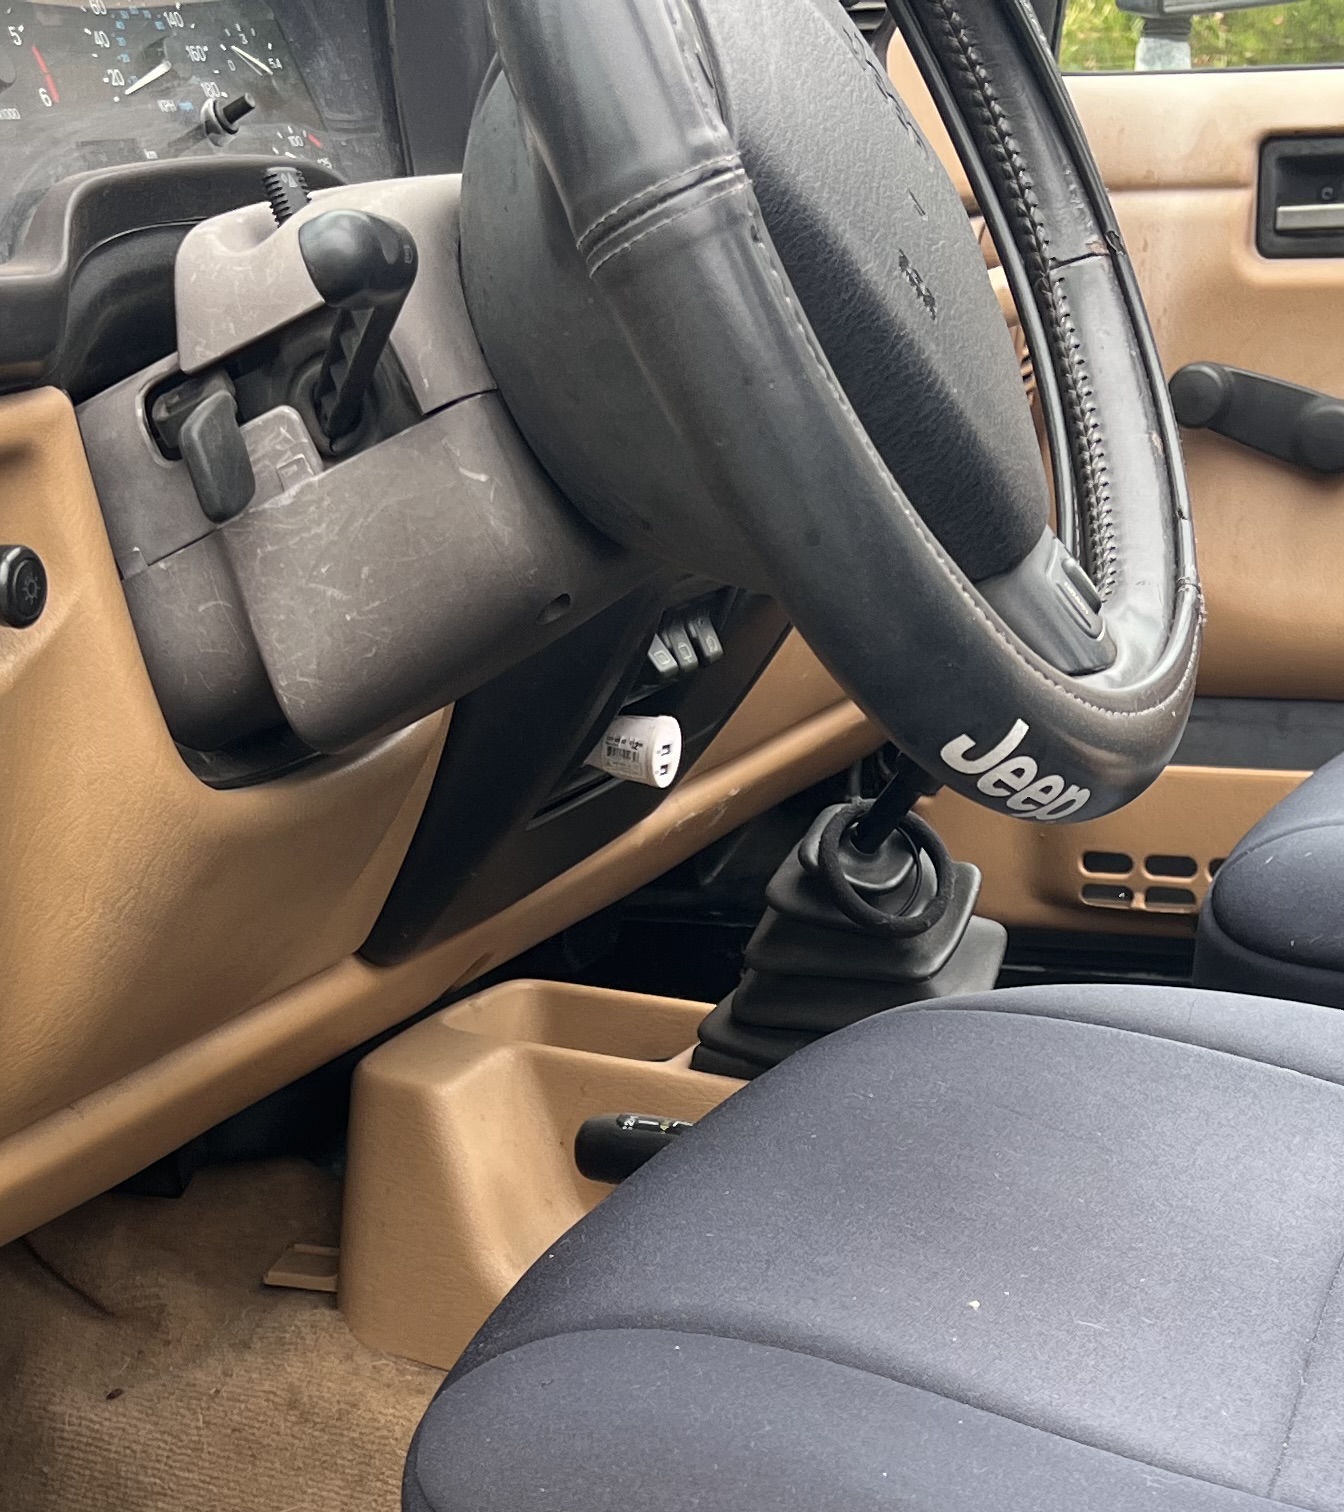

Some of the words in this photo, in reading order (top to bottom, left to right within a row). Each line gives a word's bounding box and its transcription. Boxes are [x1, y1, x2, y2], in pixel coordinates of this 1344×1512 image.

[163, 11, 184, 28] 140
[8, 26, 22, 46] 5
[93, 30, 110, 48] 40
[185, 45, 206, 62] 160
[107, 69, 125, 86] 20
[38, 87, 53, 107] 6
[940, 718, 1091, 821] Jeep
